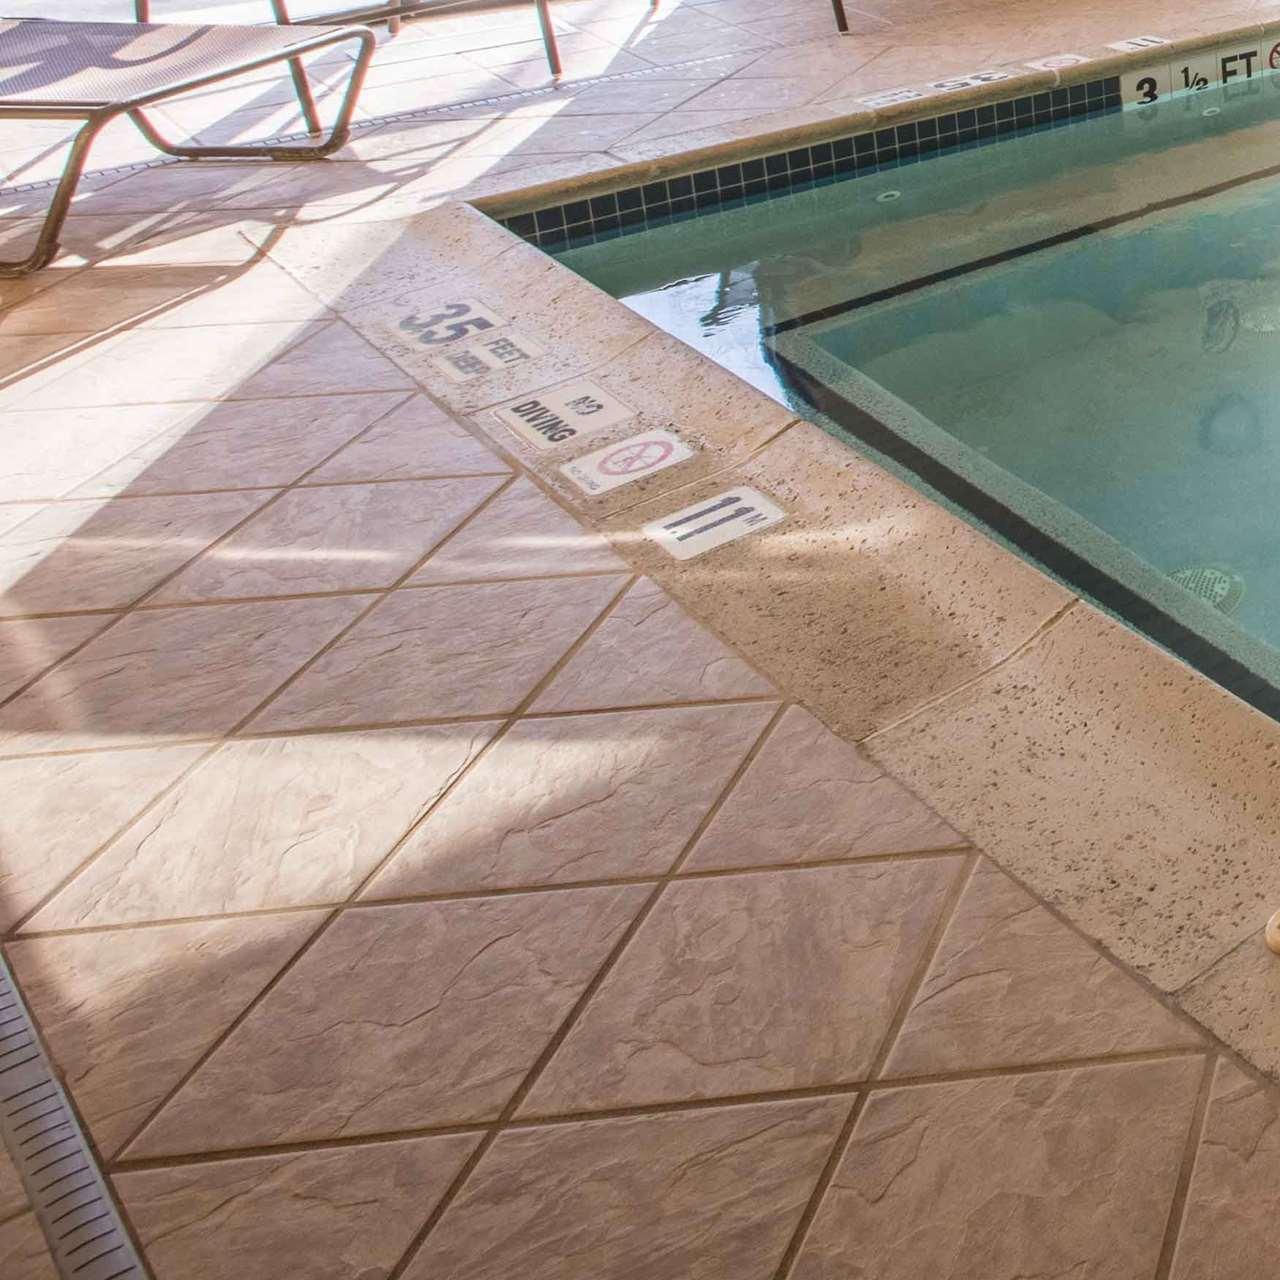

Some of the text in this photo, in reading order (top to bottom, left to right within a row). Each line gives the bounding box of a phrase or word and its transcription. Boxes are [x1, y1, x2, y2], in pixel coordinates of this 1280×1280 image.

[1136, 77, 1158, 105] 3
[1221, 51, 1258, 84] FT
[482, 336, 531, 364] FEET
[511, 400, 577, 443] DIVING
